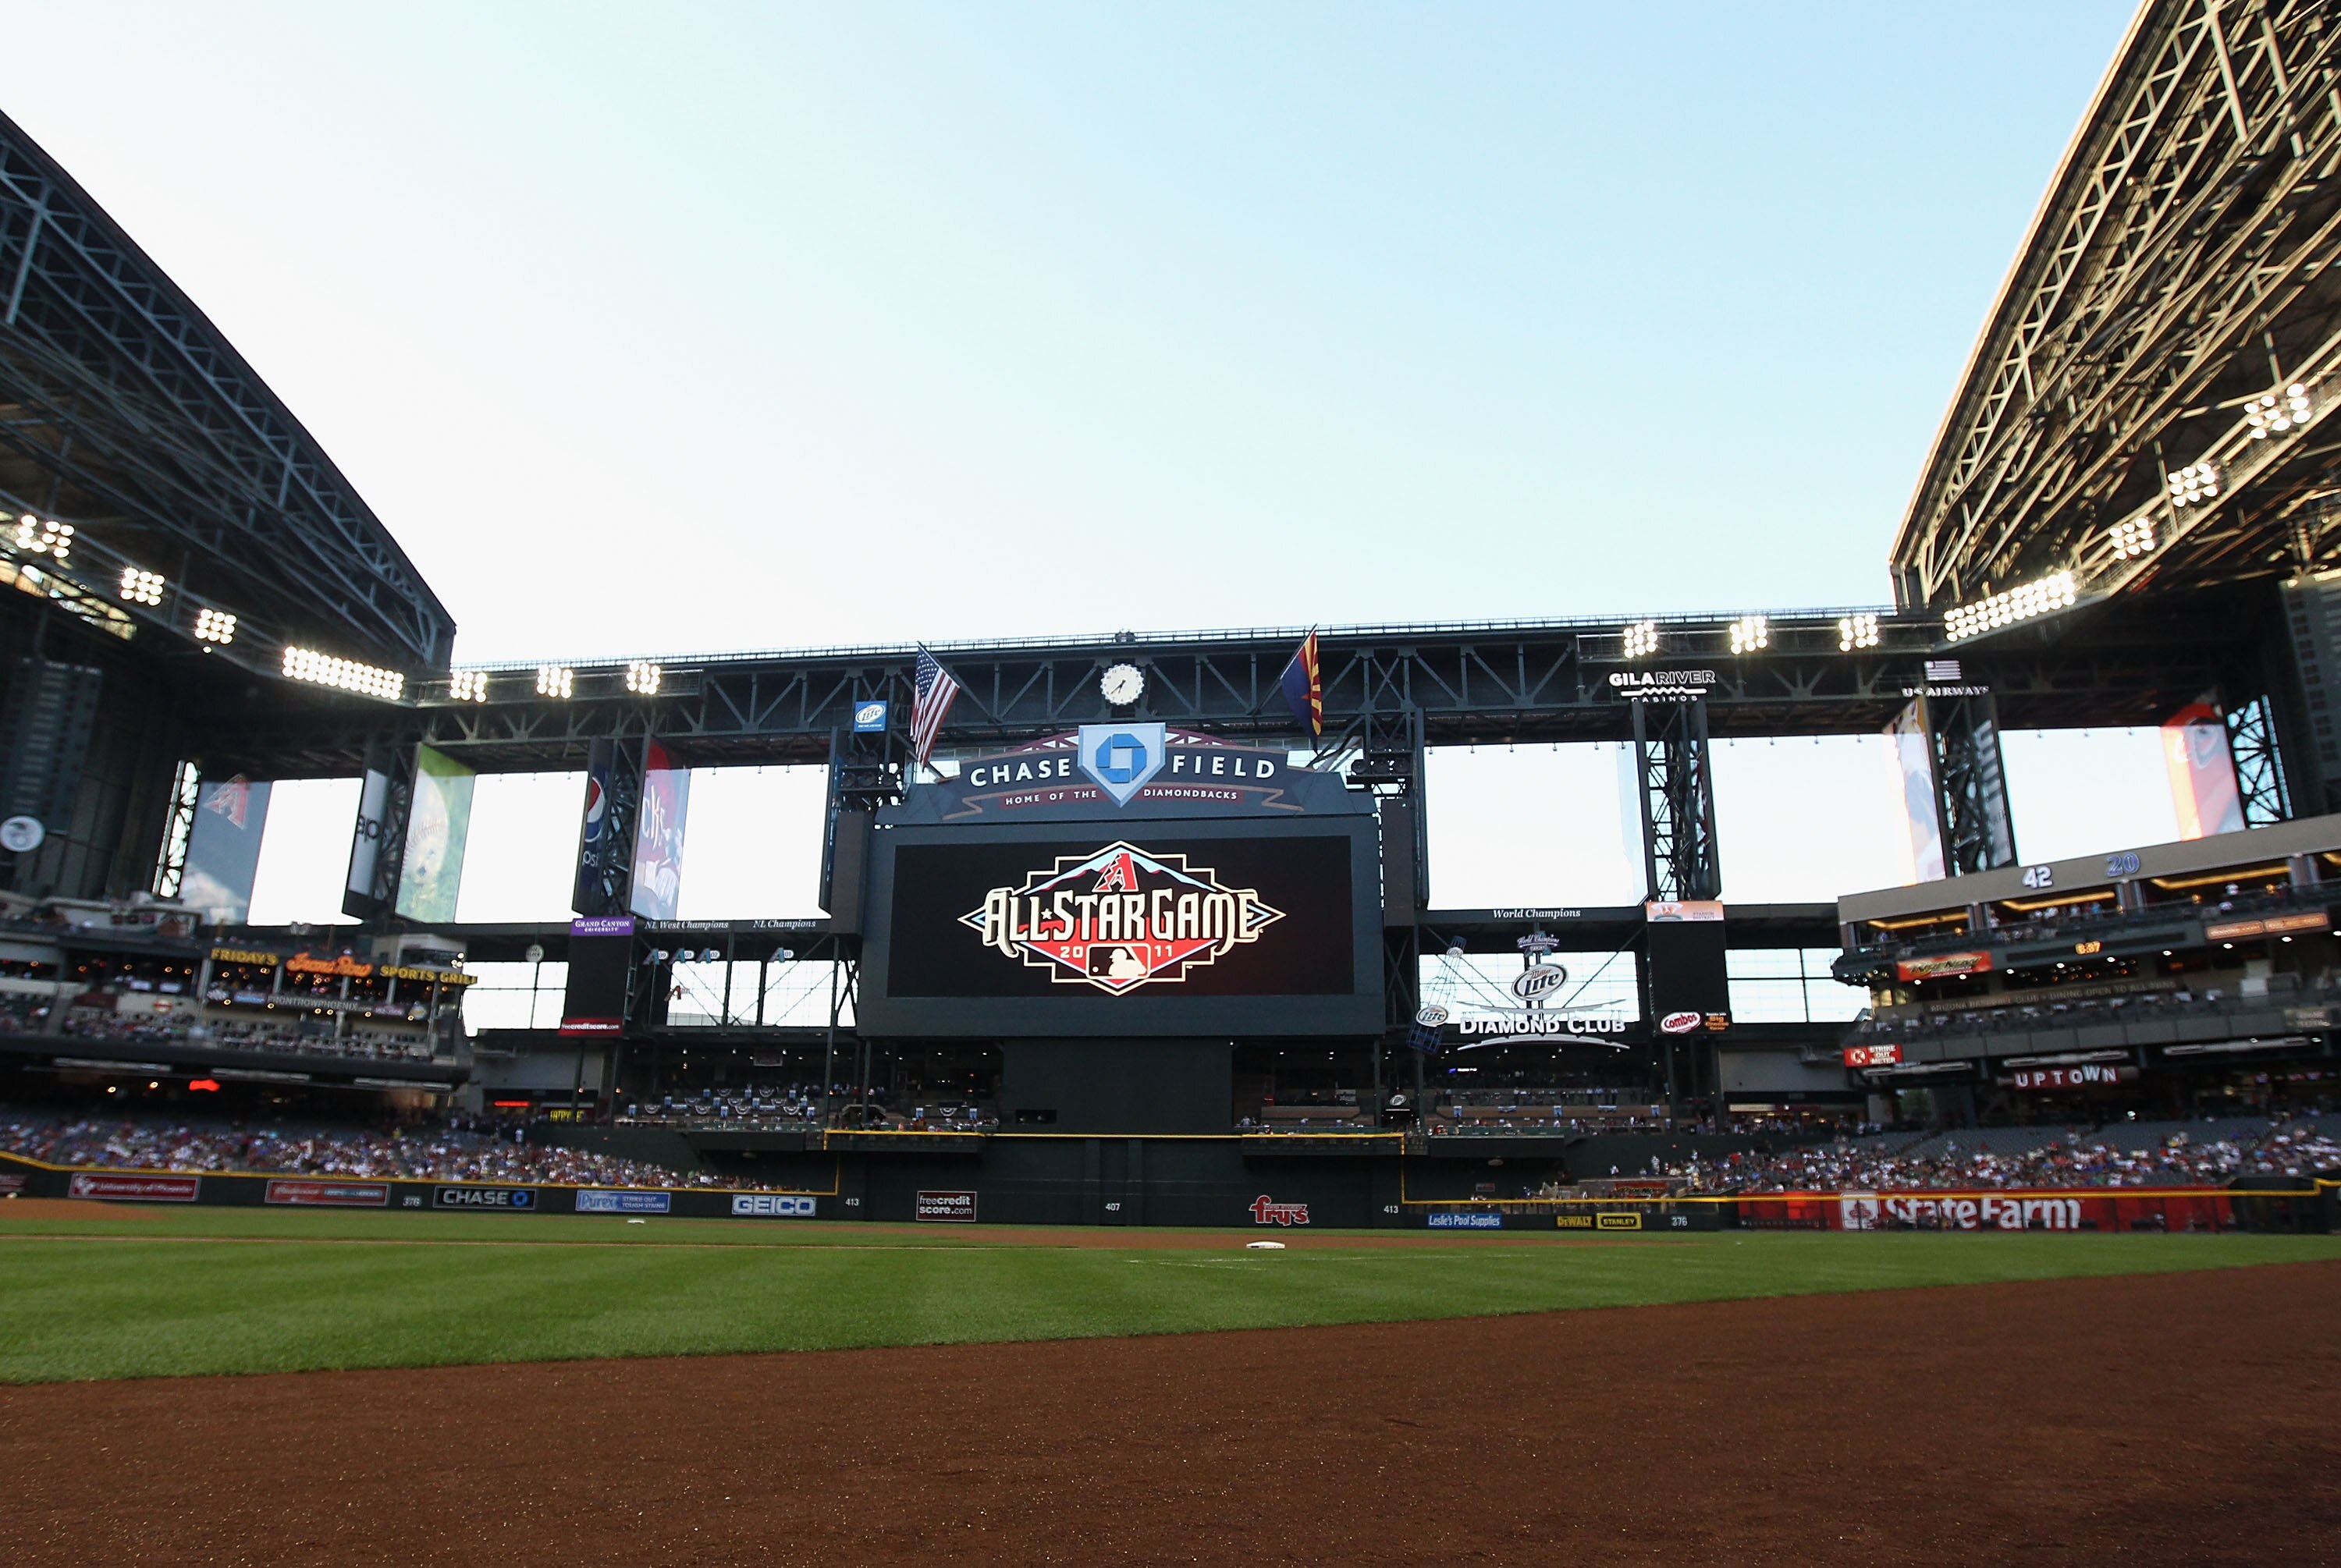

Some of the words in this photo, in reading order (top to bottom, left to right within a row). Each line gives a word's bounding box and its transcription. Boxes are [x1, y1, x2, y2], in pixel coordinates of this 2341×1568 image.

[1902, 687, 1924, 697] US
[1925, 686, 1989, 697] AIRWAYS
[969, 757, 1071, 787] CHASE
[1172, 754, 1276, 779] FIELD
[1005, 793, 1040, 806] HOME
[1049, 792, 1065, 801] OF
[1074, 789, 1097, 800] THE
[1143, 789, 1238, 800] DIAMONDBACKS
[2106, 851, 2140, 877] 20
[2022, 865, 2054, 889] 42
[1493, 908, 1524, 919] World
[1526, 908, 1581, 920] Champions
[601, 920, 630, 928] CANYON
[645, 921, 659, 930] NL
[659, 921, 680, 930] West
[681, 920, 729, 931] Champions
[753, 920, 766, 928] NL
[766, 920, 816, 929] Champions
[380, 965, 437, 982] SPORTS
[1523, 974, 1561, 997] Lite
[1459, 1016, 1561, 1034] DIAMOND
[1567, 1016, 1626, 1034] CLUB
[1664, 1013, 1698, 1028] Combos
[2015, 1066, 2117, 1087] UPTOWN
[442, 1189, 508, 1205] CHASE
[845, 1198, 859, 1207] 413
[919, 1195, 971, 1206] freecredit
[733, 1197, 815, 1215] GEICO
[919, 1204, 972, 1215] score.com
[1106, 1203, 1121, 1211] 407
[1249, 1194, 1309, 1226] fry's
[1384, 1205, 1399, 1214] 413
[1885, 1194, 1977, 1229] State
[1980, 1193, 2082, 1229] Farm
[1429, 1215, 1453, 1226] Leslie's
[1454, 1215, 1469, 1226] Pool
[1470, 1215, 1500, 1227] Supplies
[1672, 1216, 1688, 1226] 376
